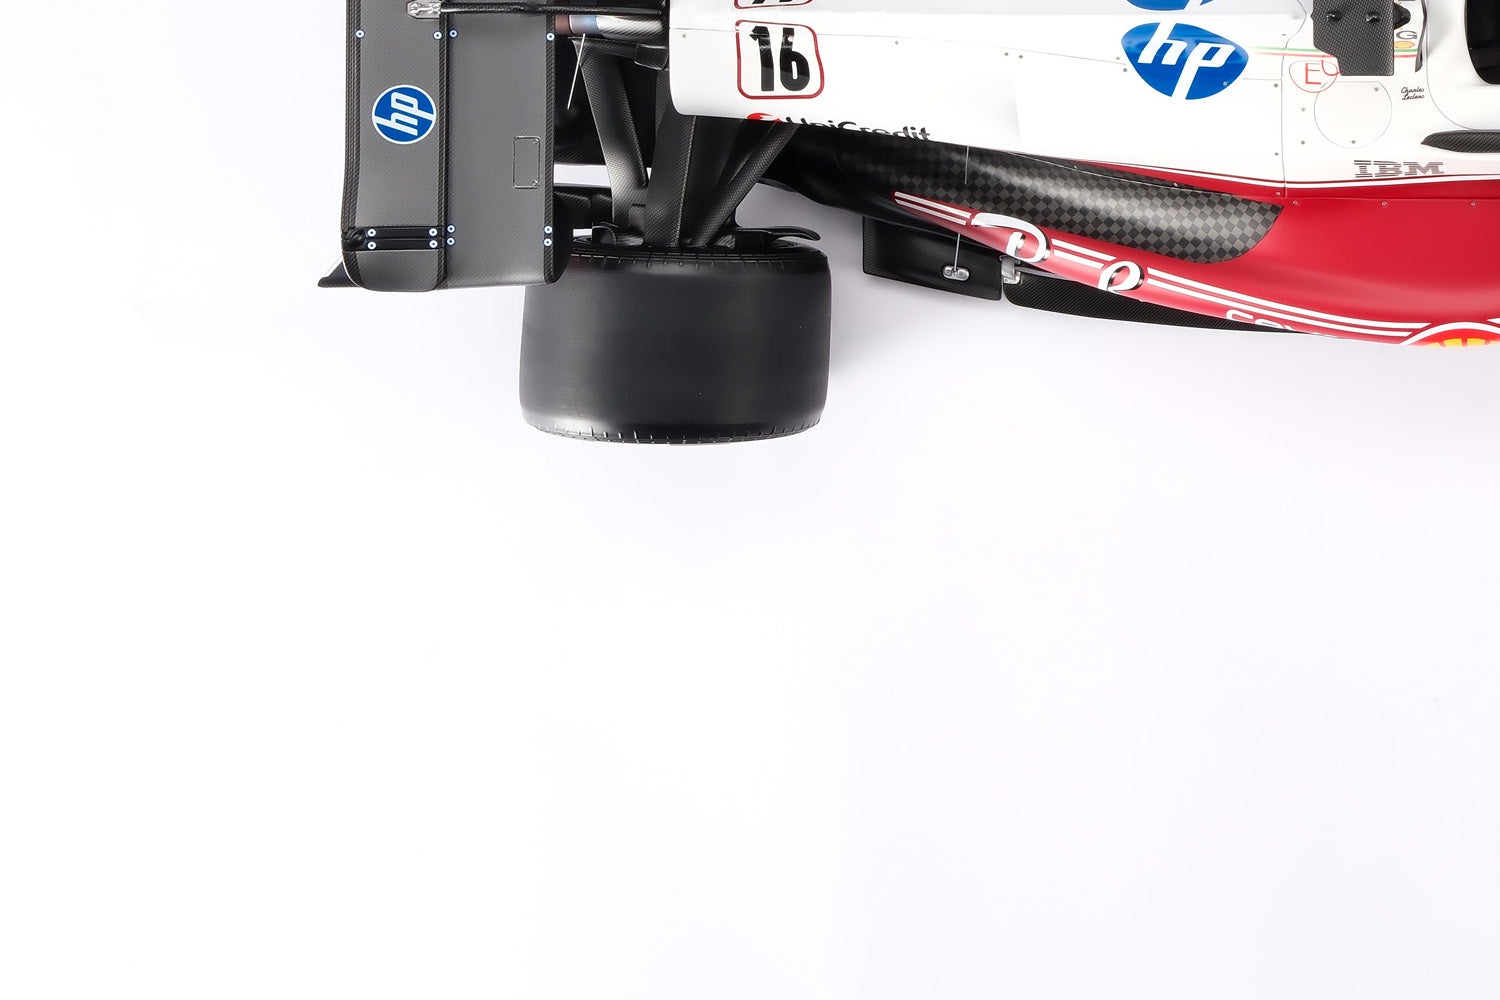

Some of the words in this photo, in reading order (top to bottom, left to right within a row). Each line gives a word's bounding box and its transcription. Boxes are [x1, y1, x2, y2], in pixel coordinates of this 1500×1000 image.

[750, 26, 810, 92] 16
[1135, 22, 1238, 100] hp
[373, 92, 437, 138] hp
[1354, 160, 1444, 178] IBM
